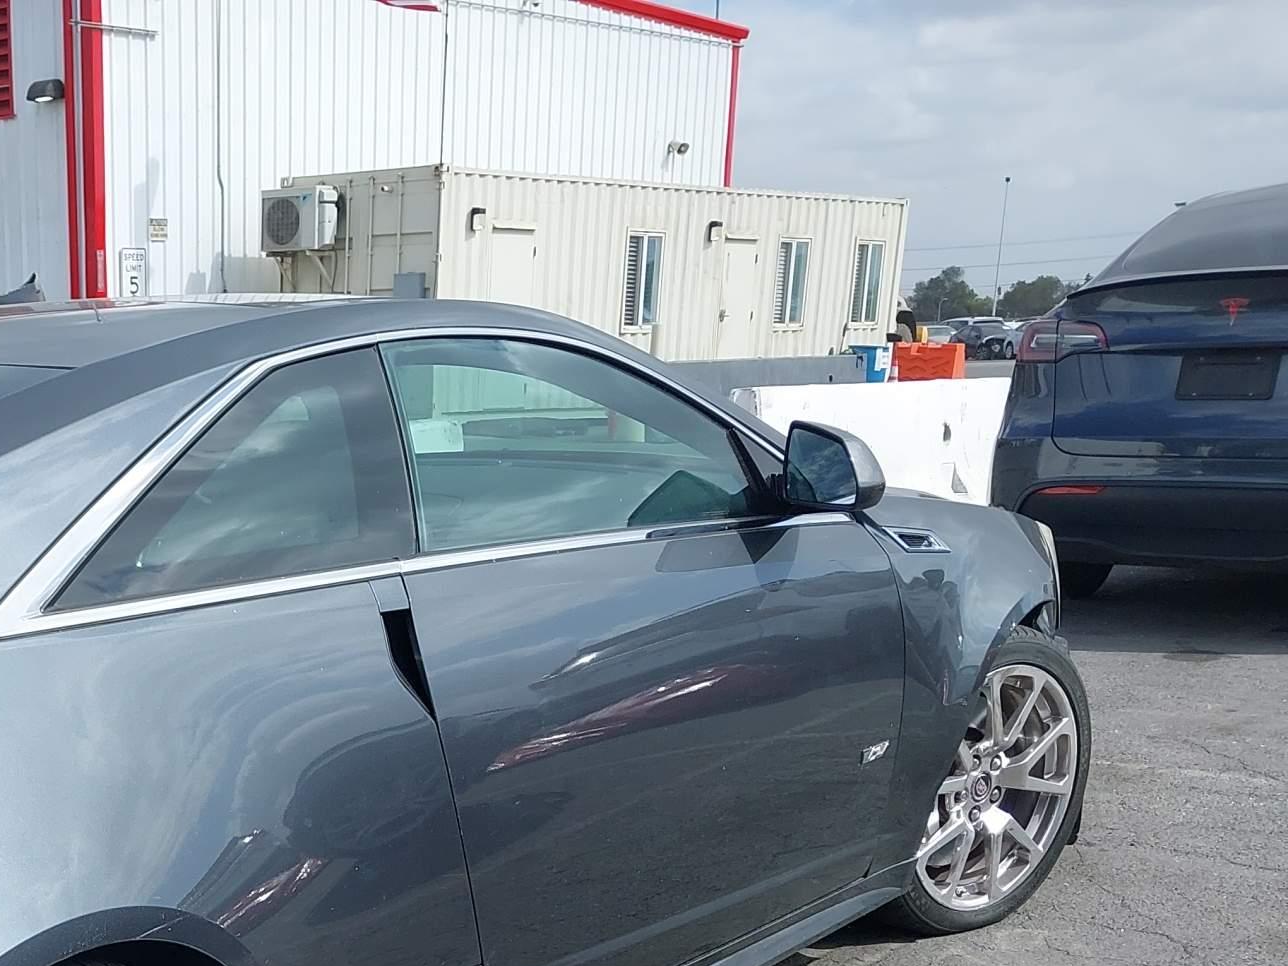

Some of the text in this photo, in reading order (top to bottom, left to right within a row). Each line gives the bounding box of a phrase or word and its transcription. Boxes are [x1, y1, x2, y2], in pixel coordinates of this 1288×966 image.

[123, 253, 144, 261] SPEED
[125, 264, 142, 272] LIMIT
[130, 276, 139, 294] 5
